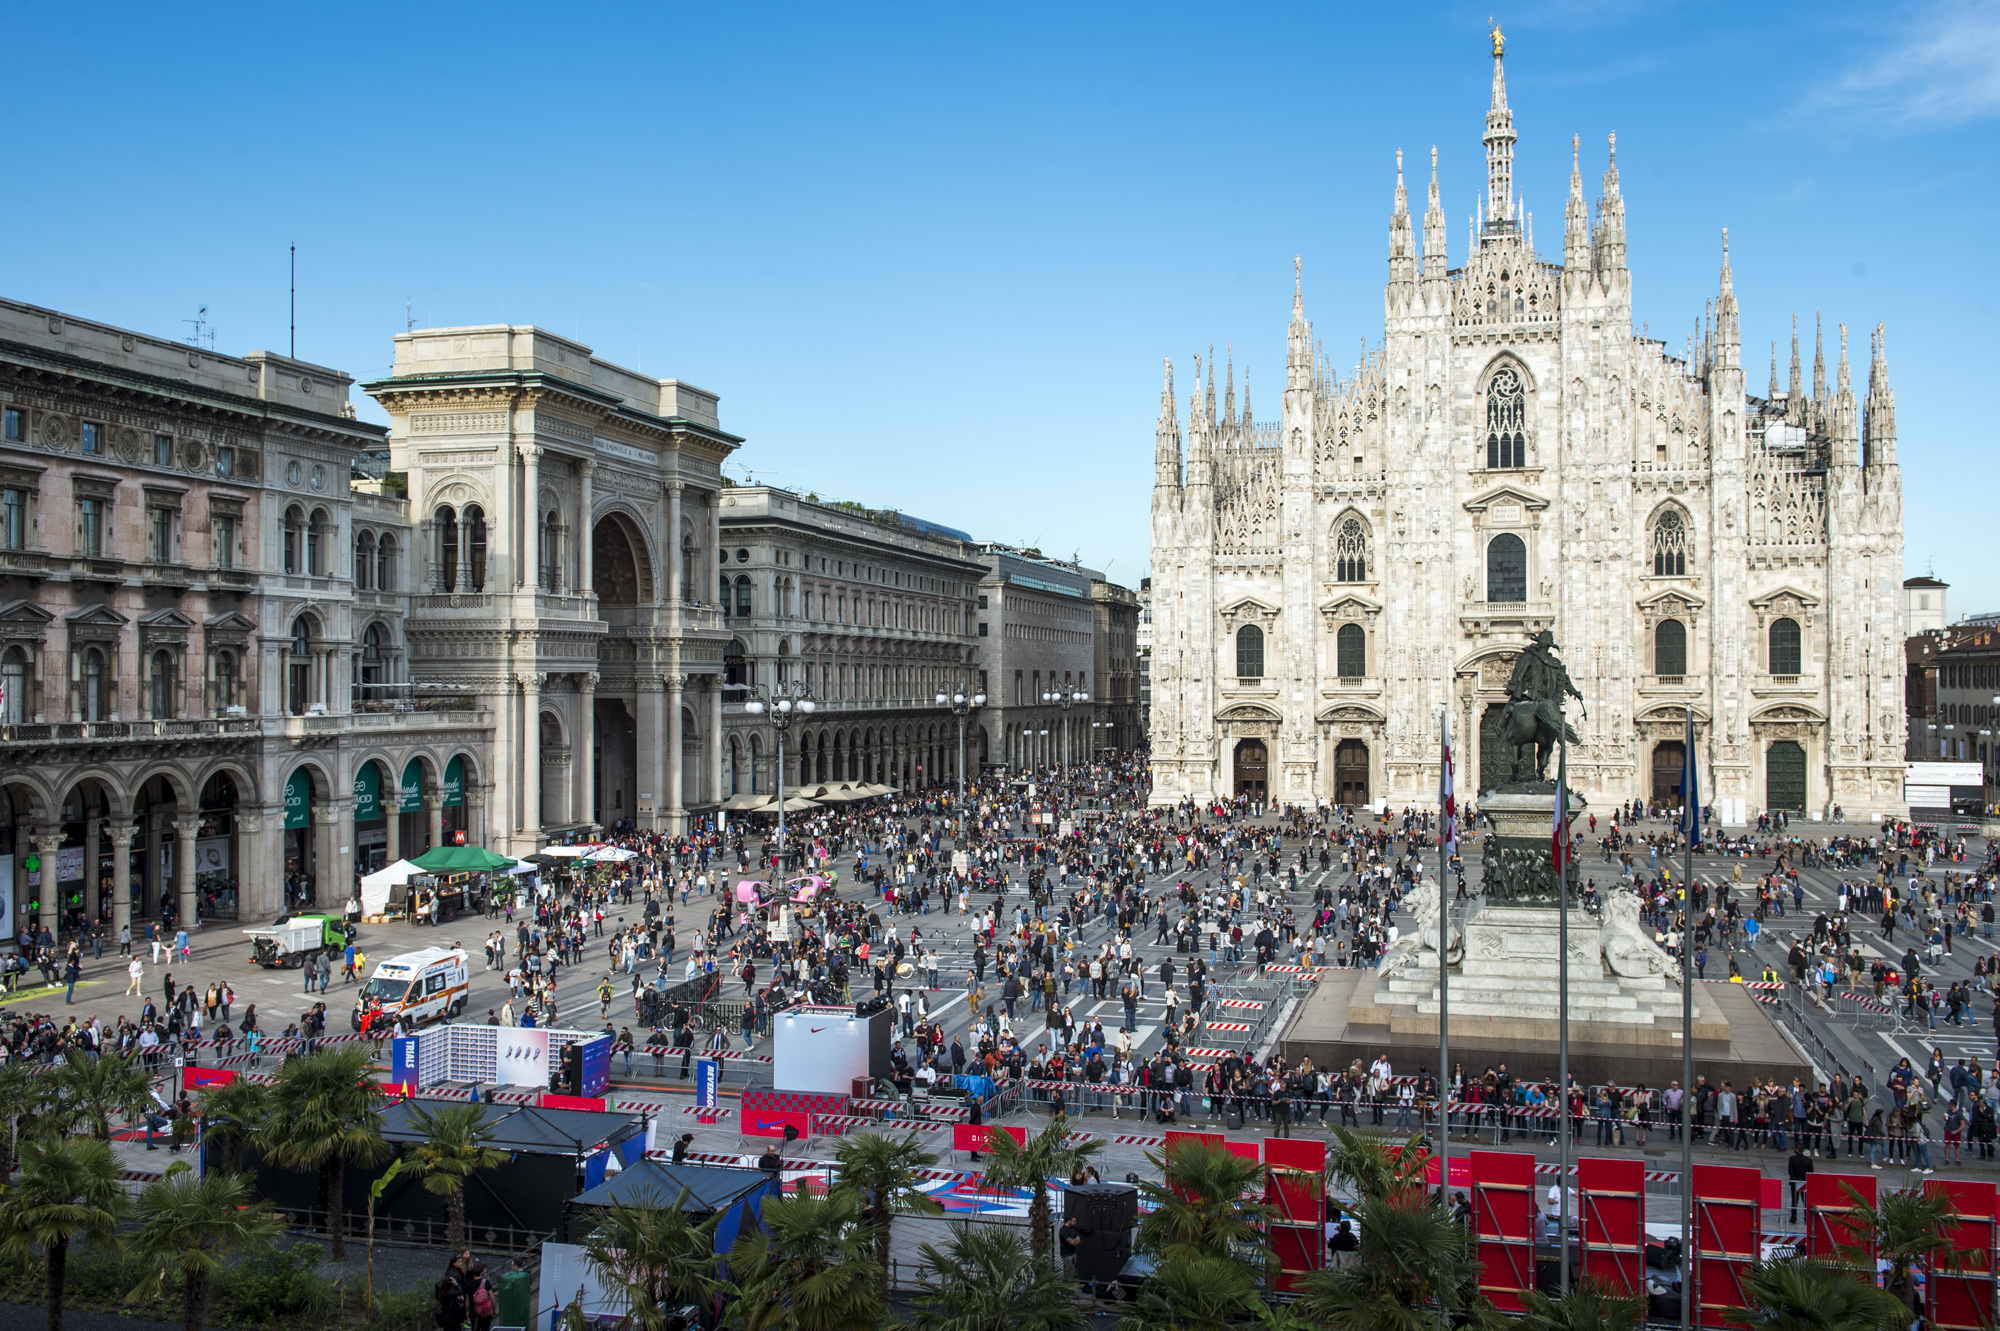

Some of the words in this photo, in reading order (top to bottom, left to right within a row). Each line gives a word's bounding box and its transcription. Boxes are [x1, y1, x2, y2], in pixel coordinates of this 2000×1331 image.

[606, 443, 628, 454] EMANUELE
[1032, 803, 1041, 811] M
[405, 1040, 415, 1069] TRIALS
[706, 1064, 715, 1108] BEVERAG
